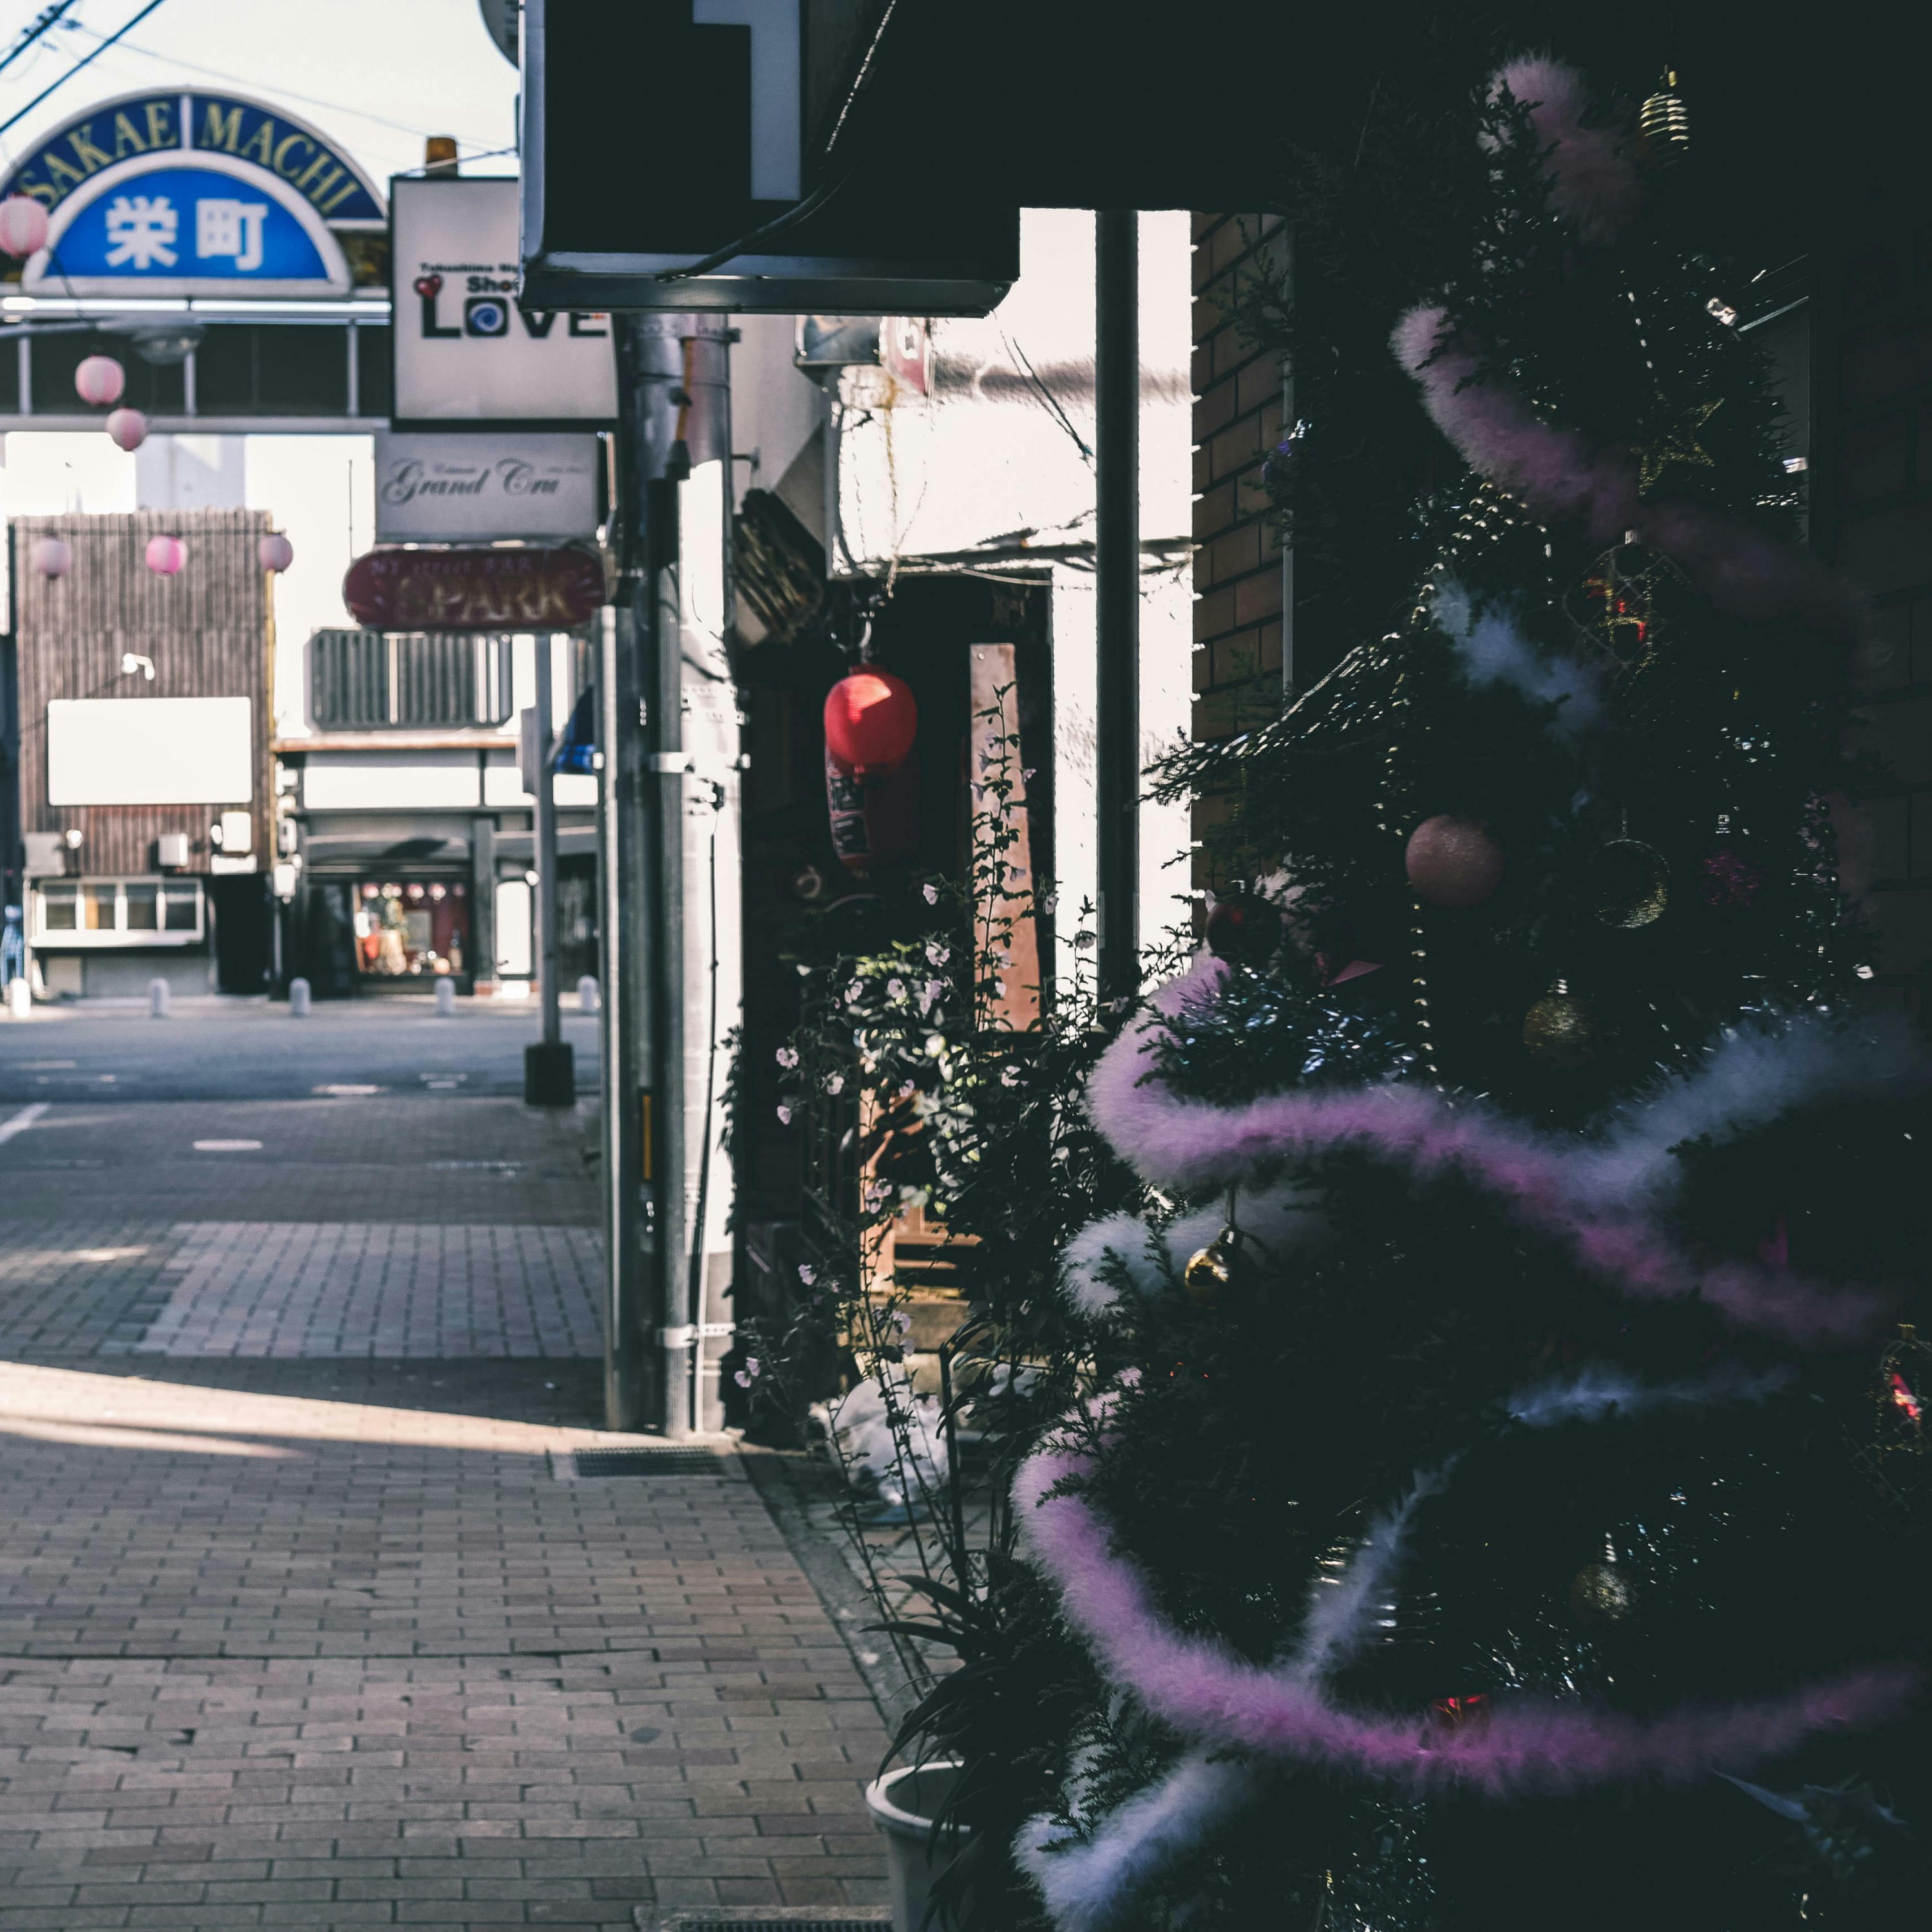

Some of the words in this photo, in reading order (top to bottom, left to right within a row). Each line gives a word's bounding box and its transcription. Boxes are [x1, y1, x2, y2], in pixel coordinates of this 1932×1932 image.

[17, 100, 178, 205] SAKAE
[200, 102, 362, 214] MACHI
[104, 195, 268, 272] 栄町
[381, 457, 491, 506] Grand
[496, 457, 560, 496] Cru
